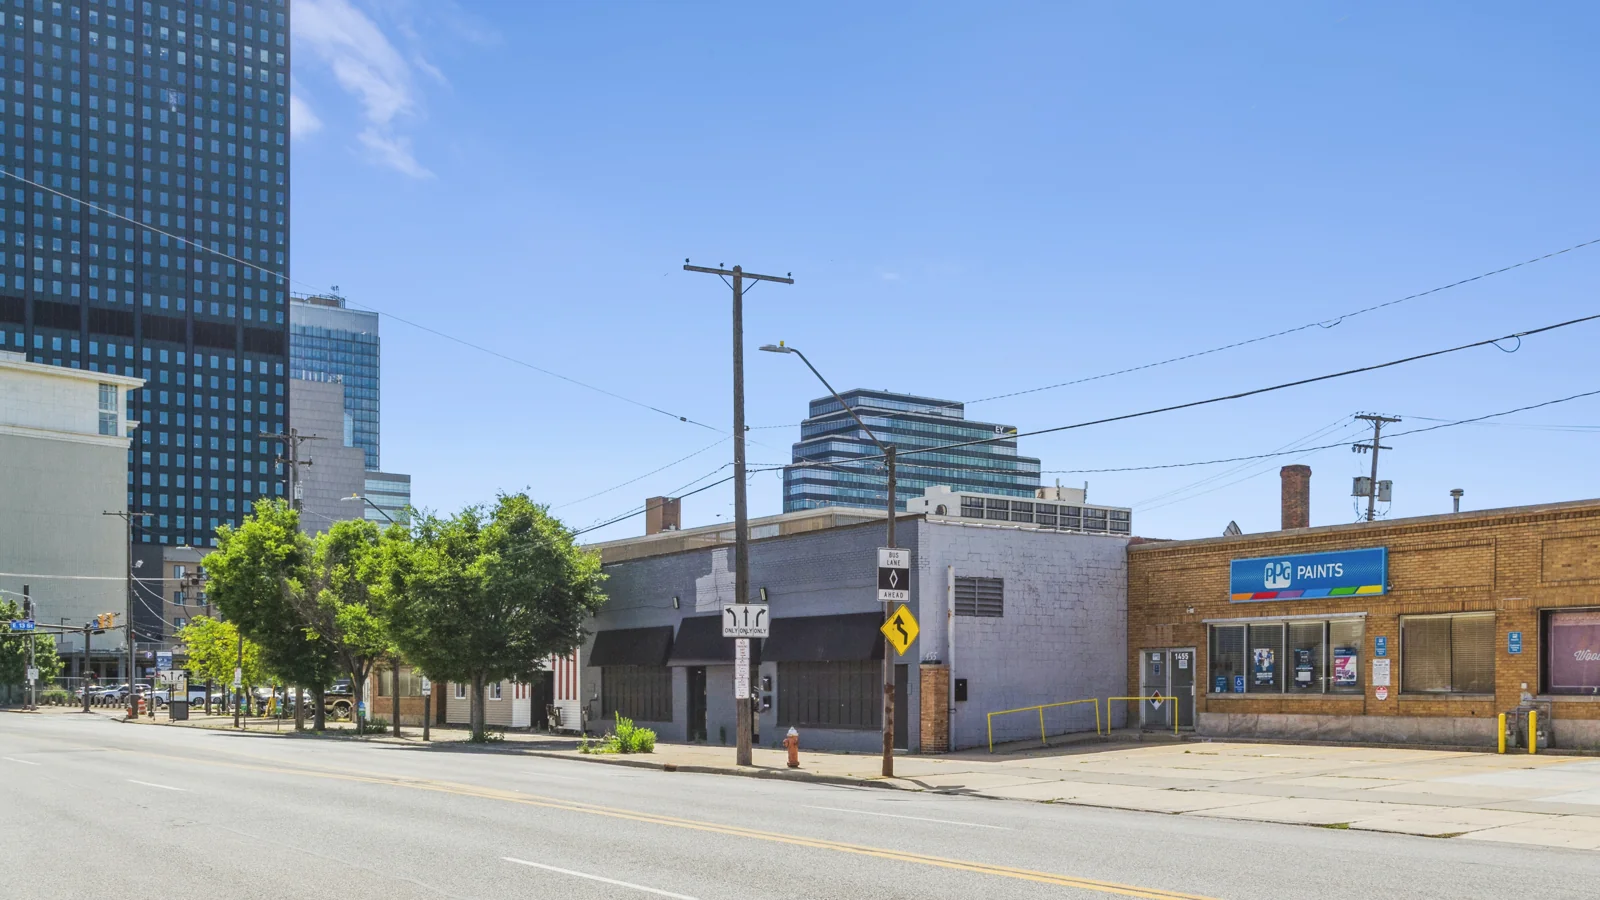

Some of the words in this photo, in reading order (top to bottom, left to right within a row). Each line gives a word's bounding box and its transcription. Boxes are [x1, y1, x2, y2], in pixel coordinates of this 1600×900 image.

[995, 425, 1004, 434] EY
[887, 559, 901, 567] LANE
[1265, 561, 1291, 584] PPG
[1297, 562, 1344, 580] PAINTS
[884, 591, 904, 599] AHEAD
[1174, 652, 1189, 660] 1455
